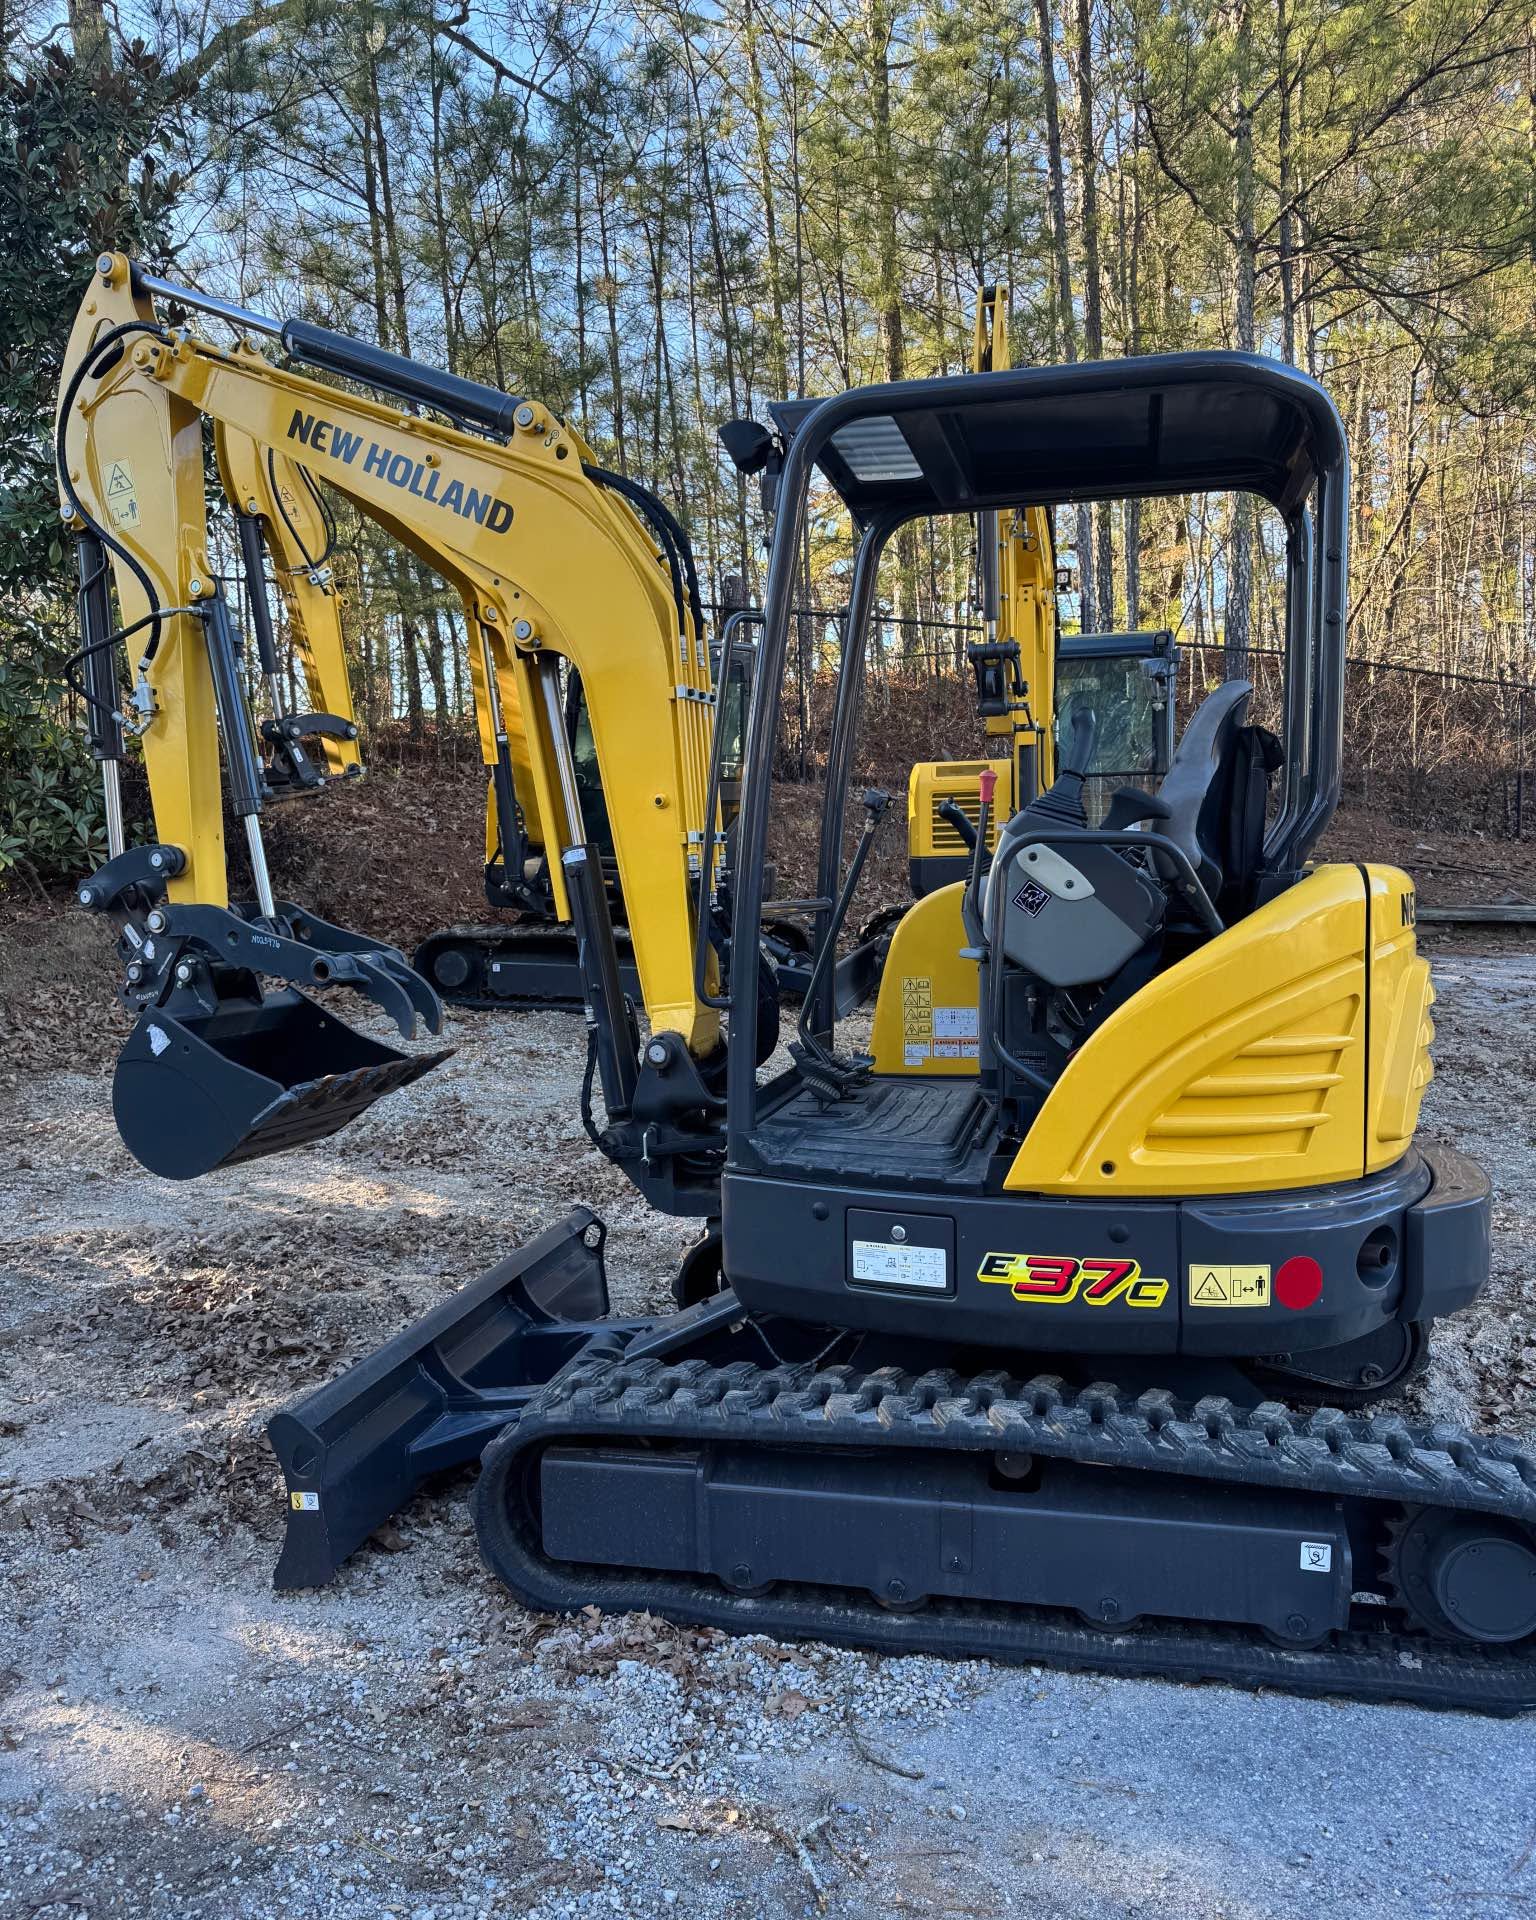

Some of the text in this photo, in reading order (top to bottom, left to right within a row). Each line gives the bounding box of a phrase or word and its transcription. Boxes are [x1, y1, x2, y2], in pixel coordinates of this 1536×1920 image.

[287, 409, 515, 535] NEW HOLLAND
[978, 1253, 1169, 1306] E37C
